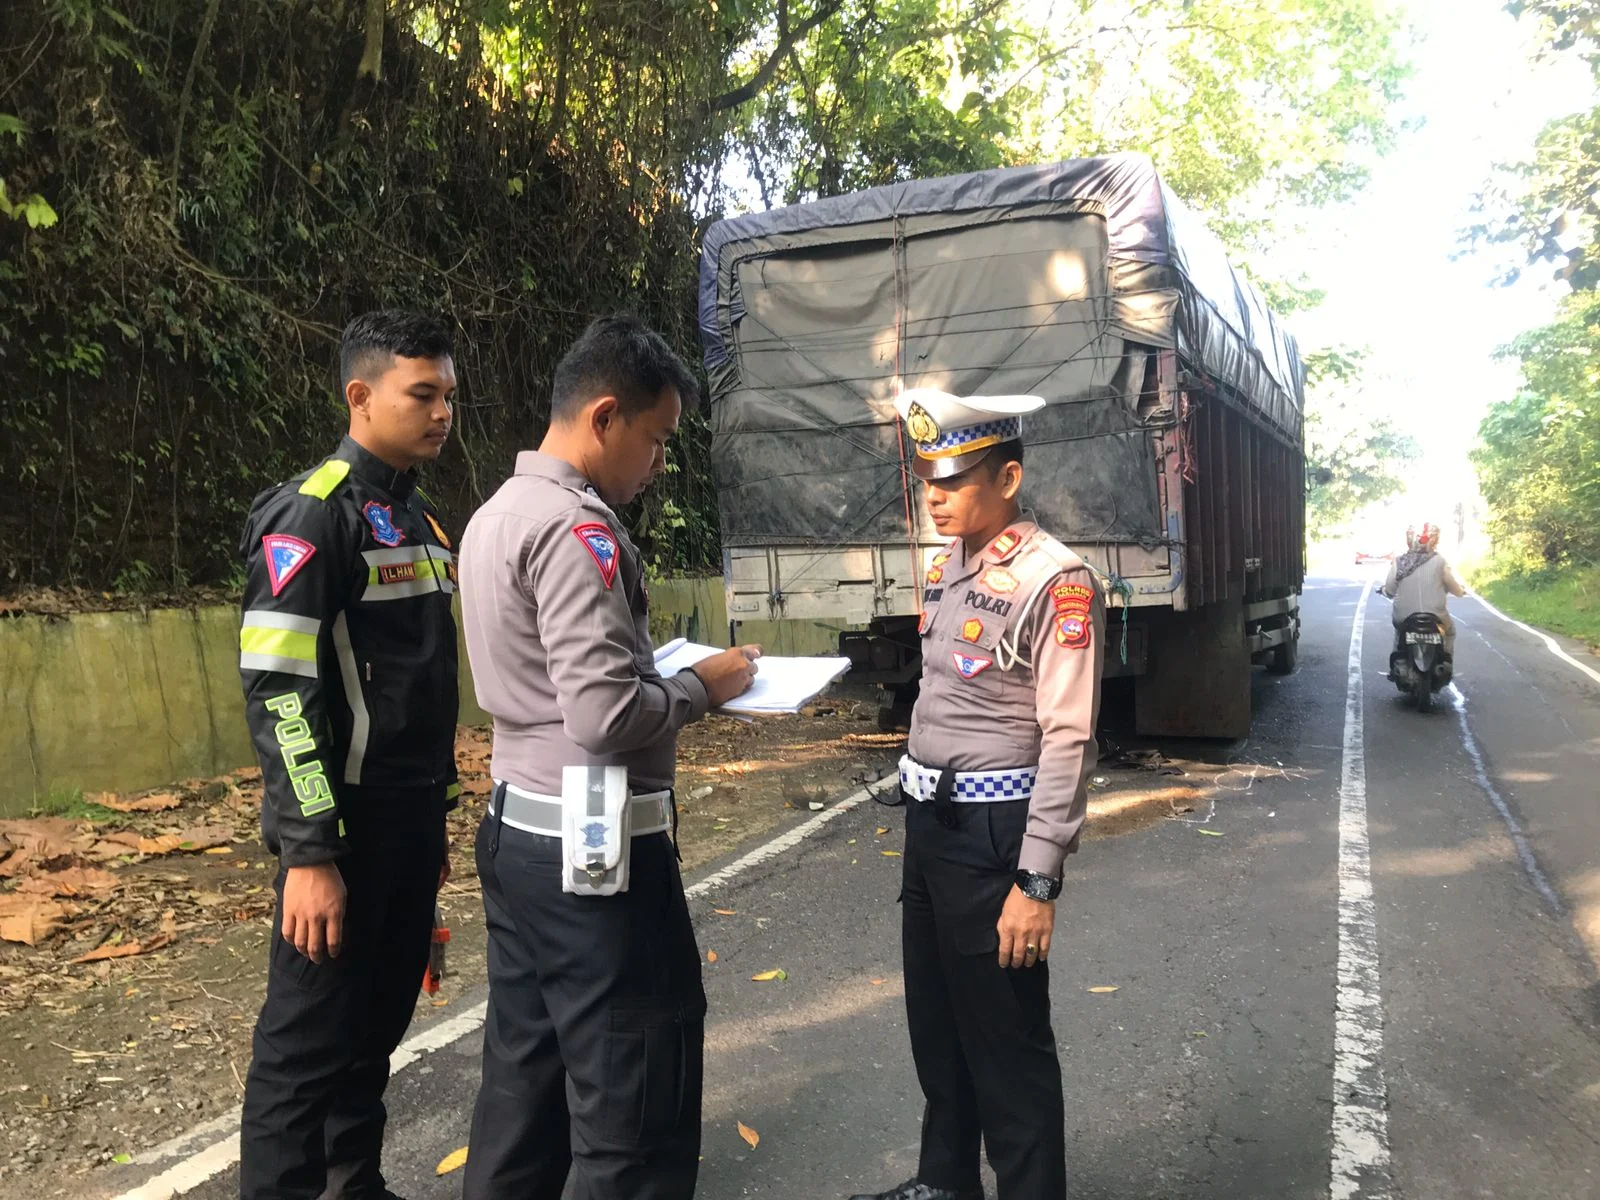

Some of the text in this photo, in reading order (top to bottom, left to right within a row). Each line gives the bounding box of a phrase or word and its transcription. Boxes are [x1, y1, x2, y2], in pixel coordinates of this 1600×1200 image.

[383, 566, 415, 579] ILHAM
[1053, 586, 1090, 598] POLRES
[964, 590, 1013, 617] POLRI
[264, 692, 335, 817] POLISI
